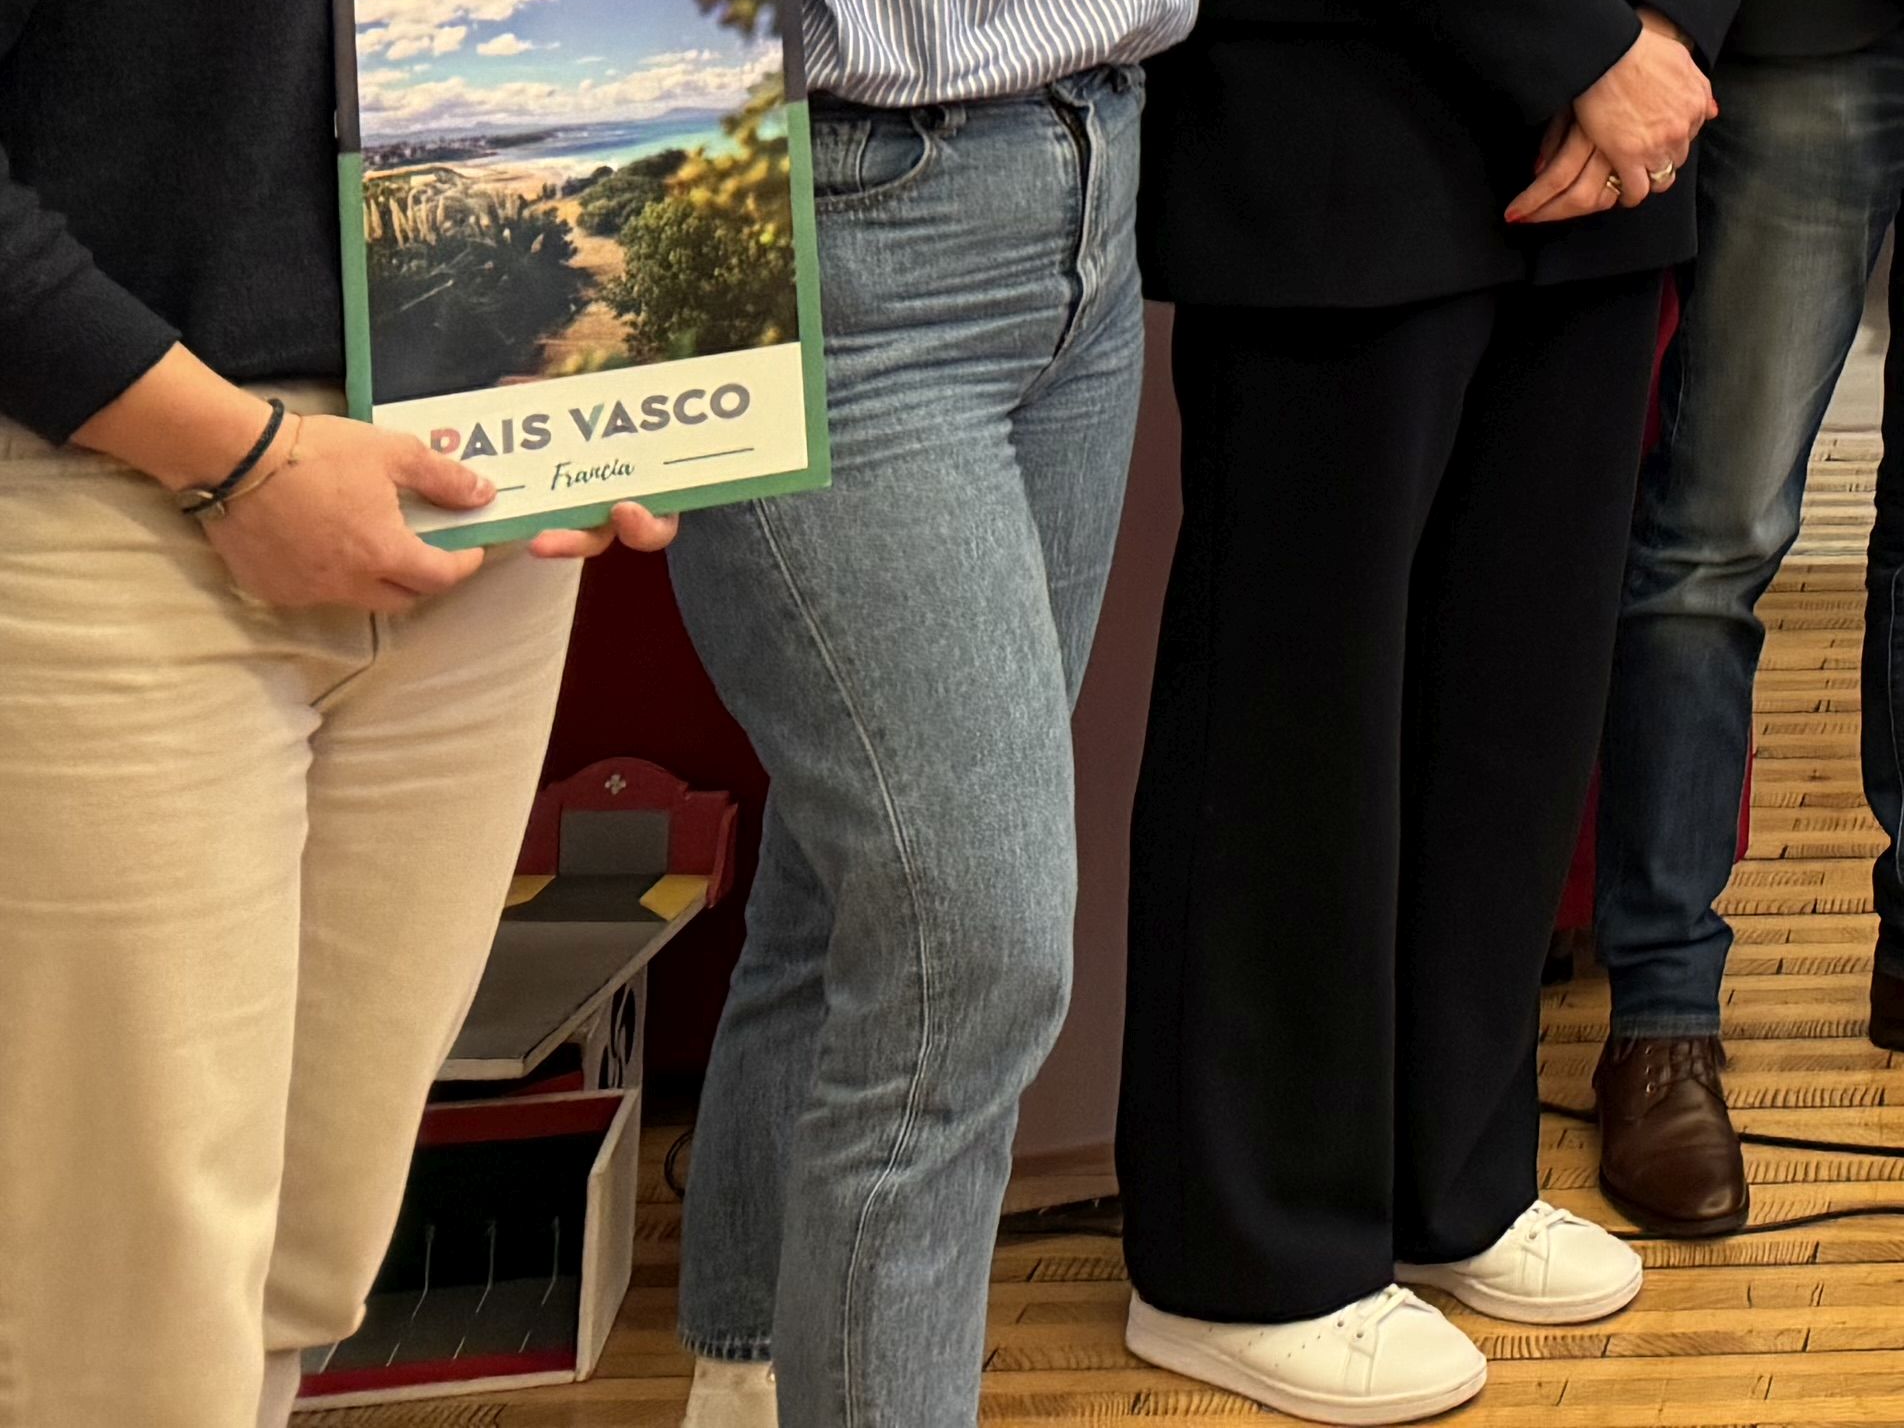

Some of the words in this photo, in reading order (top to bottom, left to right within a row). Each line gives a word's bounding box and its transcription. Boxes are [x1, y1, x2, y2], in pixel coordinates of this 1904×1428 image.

[430, 413, 552, 461] PAIS
[568, 382, 751, 442] VASCO
[550, 458, 636, 491] Francia
